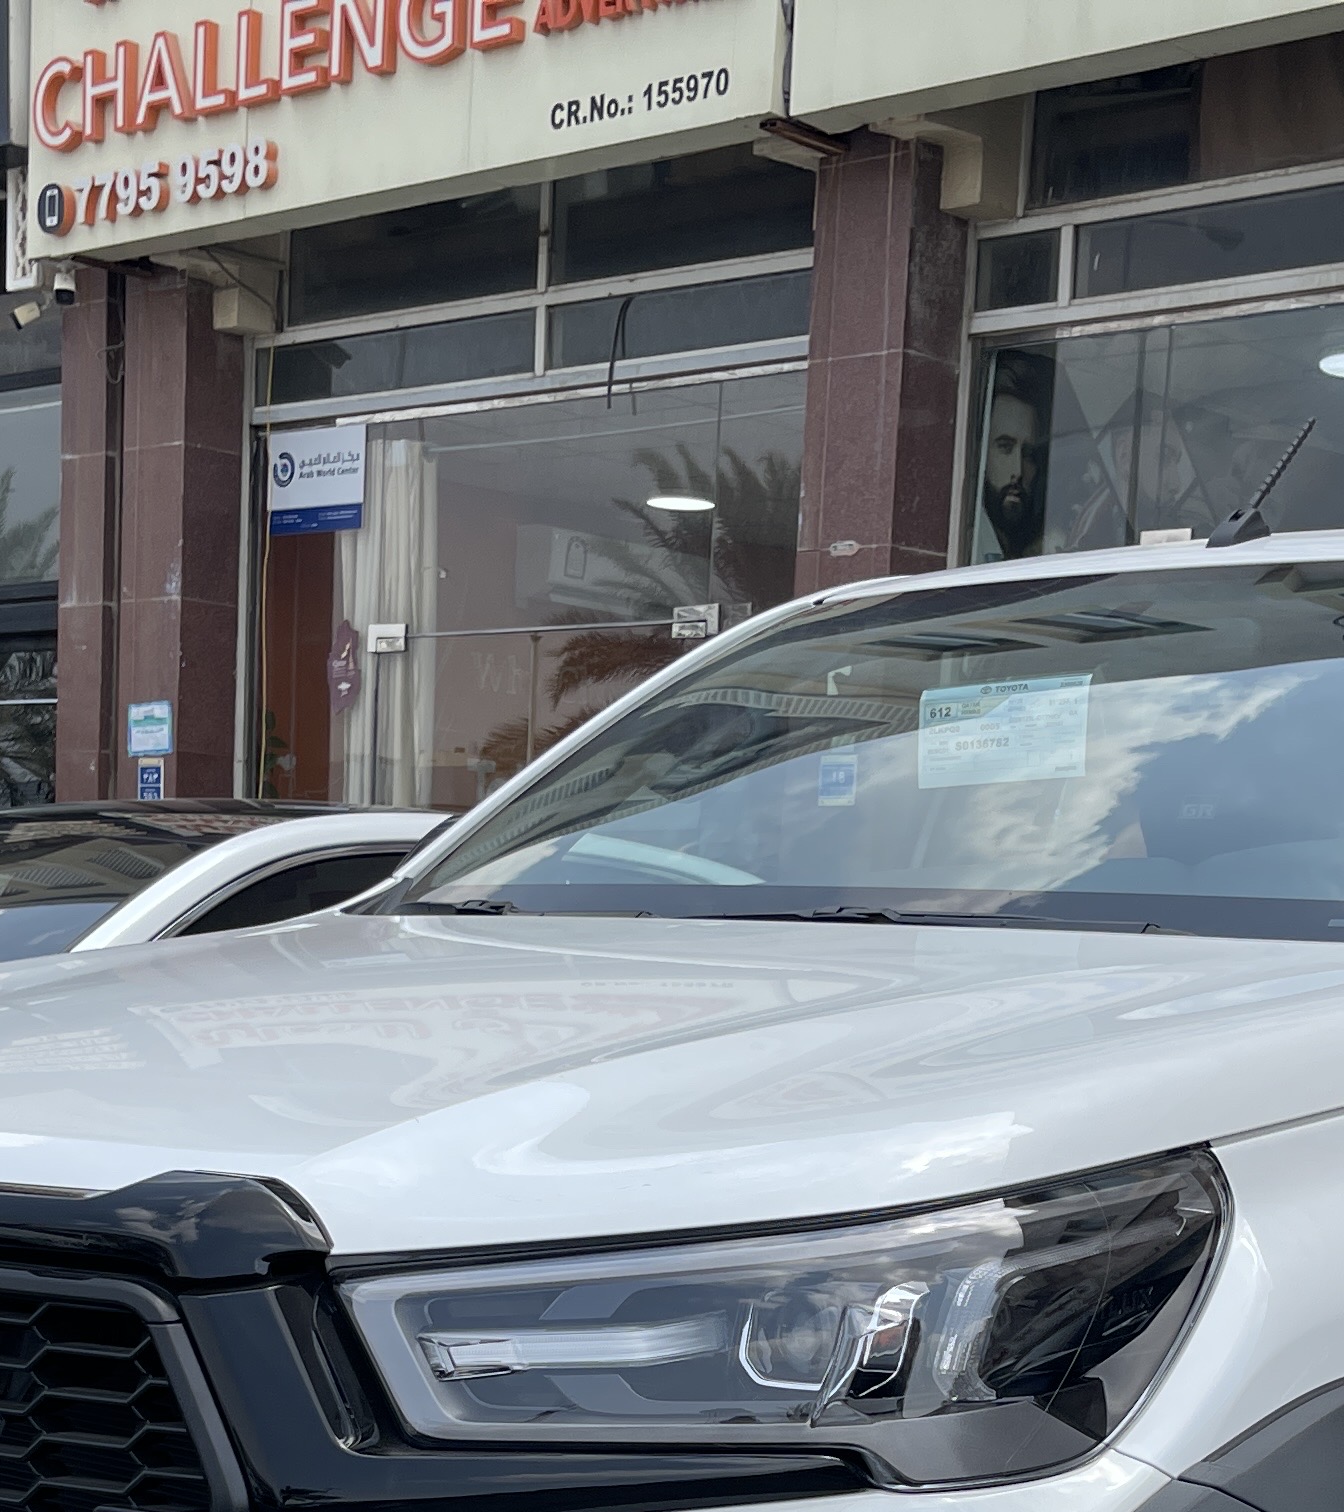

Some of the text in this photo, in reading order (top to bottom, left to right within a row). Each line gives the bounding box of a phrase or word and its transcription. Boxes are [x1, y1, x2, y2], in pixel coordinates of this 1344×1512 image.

[642, 66, 730, 112] 155970
[75, 138, 278, 226] 7795 9598
[995, 683, 1029, 694] TOYOTA
[929, 706, 952, 719] 612
